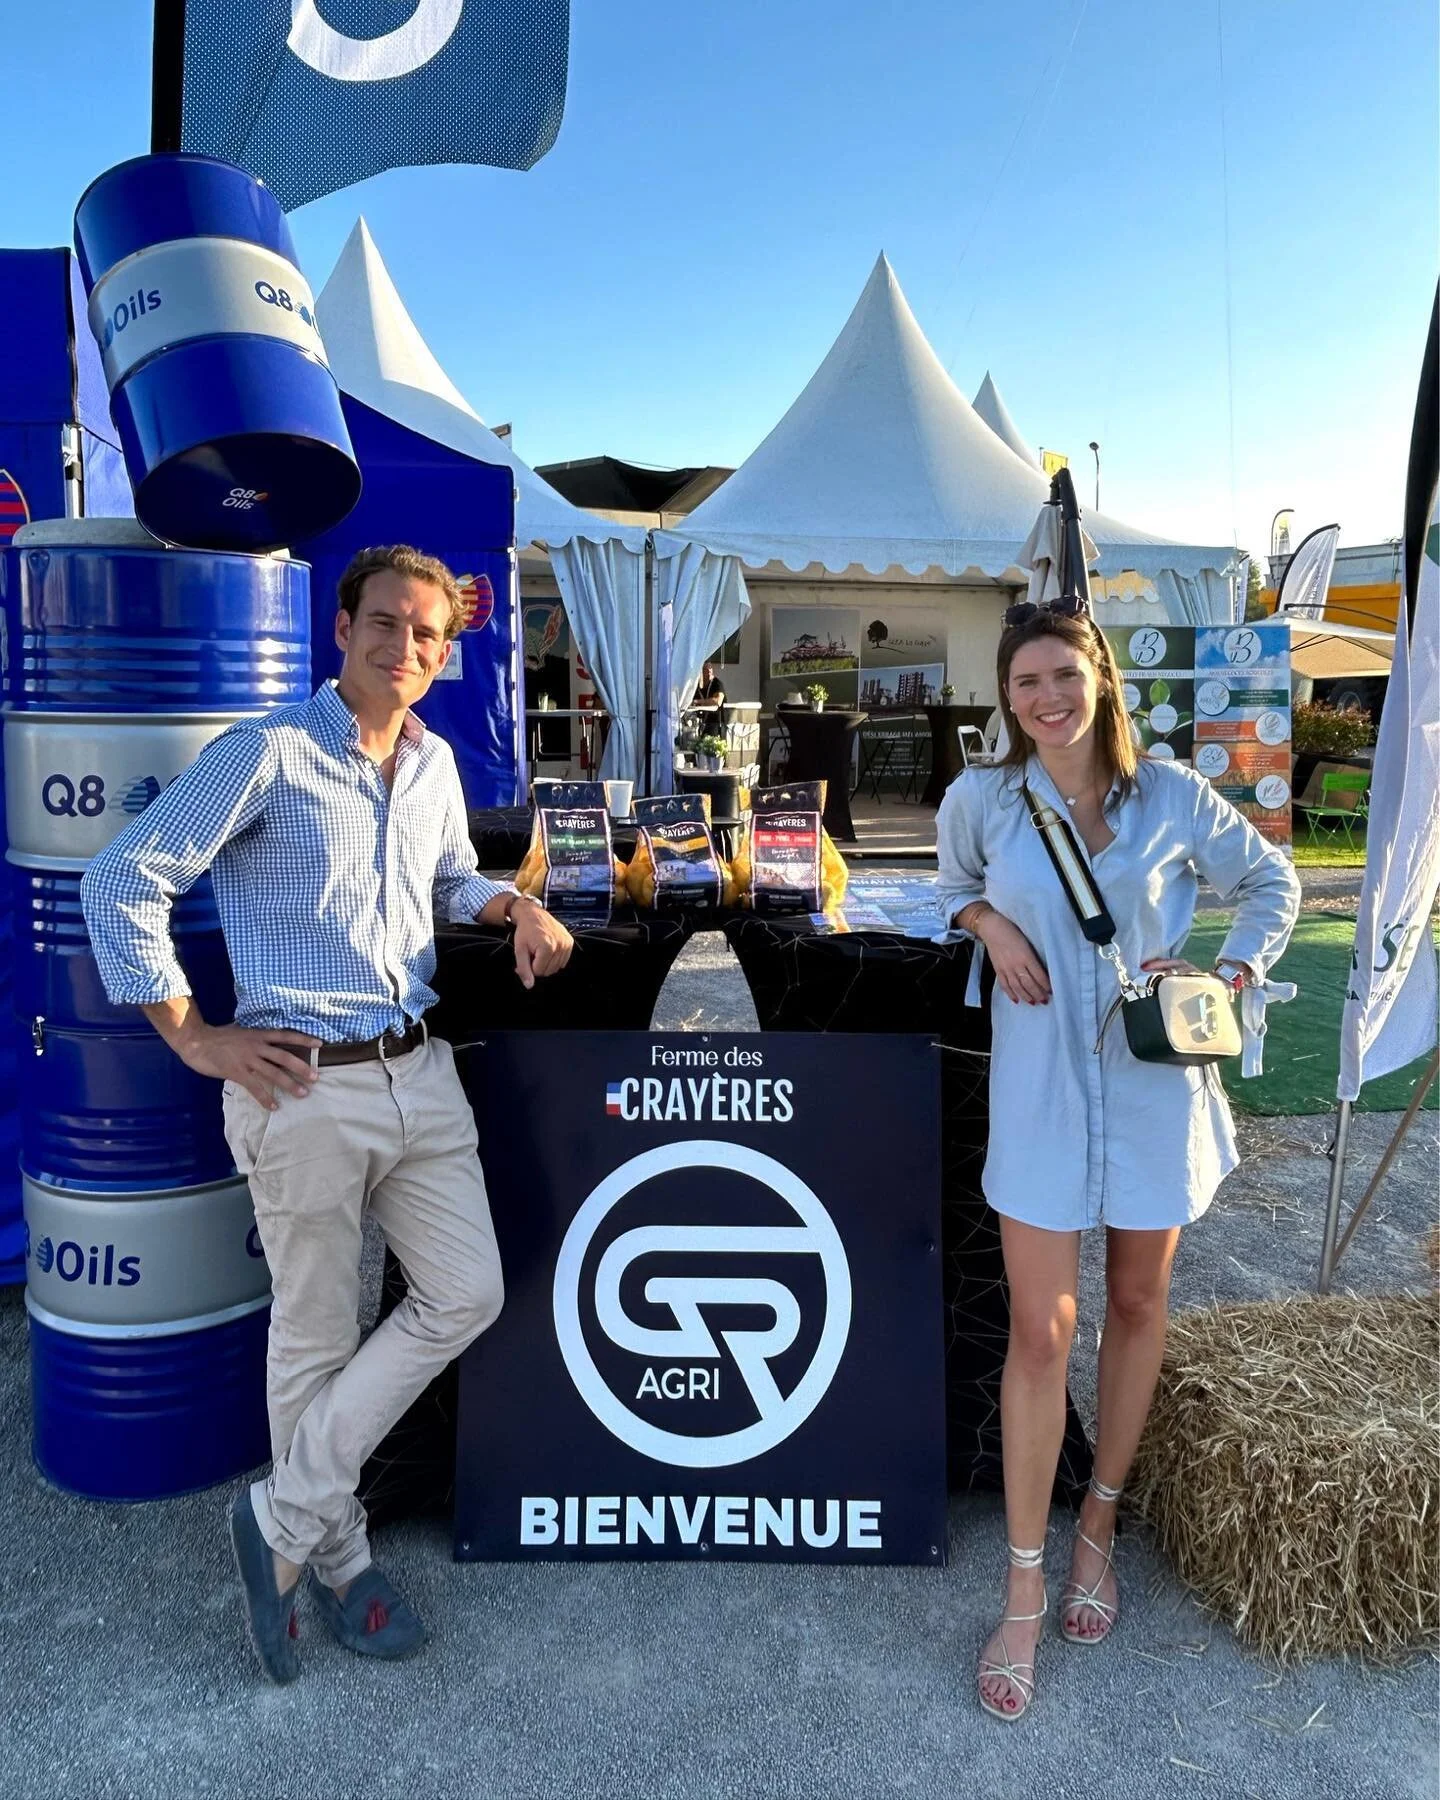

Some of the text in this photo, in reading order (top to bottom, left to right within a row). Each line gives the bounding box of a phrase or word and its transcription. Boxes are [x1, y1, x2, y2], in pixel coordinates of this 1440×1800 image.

[113, 288, 162, 333] Oils
[255, 278, 294, 312] Q8
[222, 497, 254, 510] Oils
[229, 487, 256, 499] Q8
[42, 773, 106, 817] Q8
[651, 1045, 763, 1067] Ferme des
[620, 1071, 794, 1123] CRAYÈRES
[56, 1240, 141, 1287] Oils
[636, 1367, 720, 1400] AGRI
[519, 1496, 883, 1548] BIENVENUE
